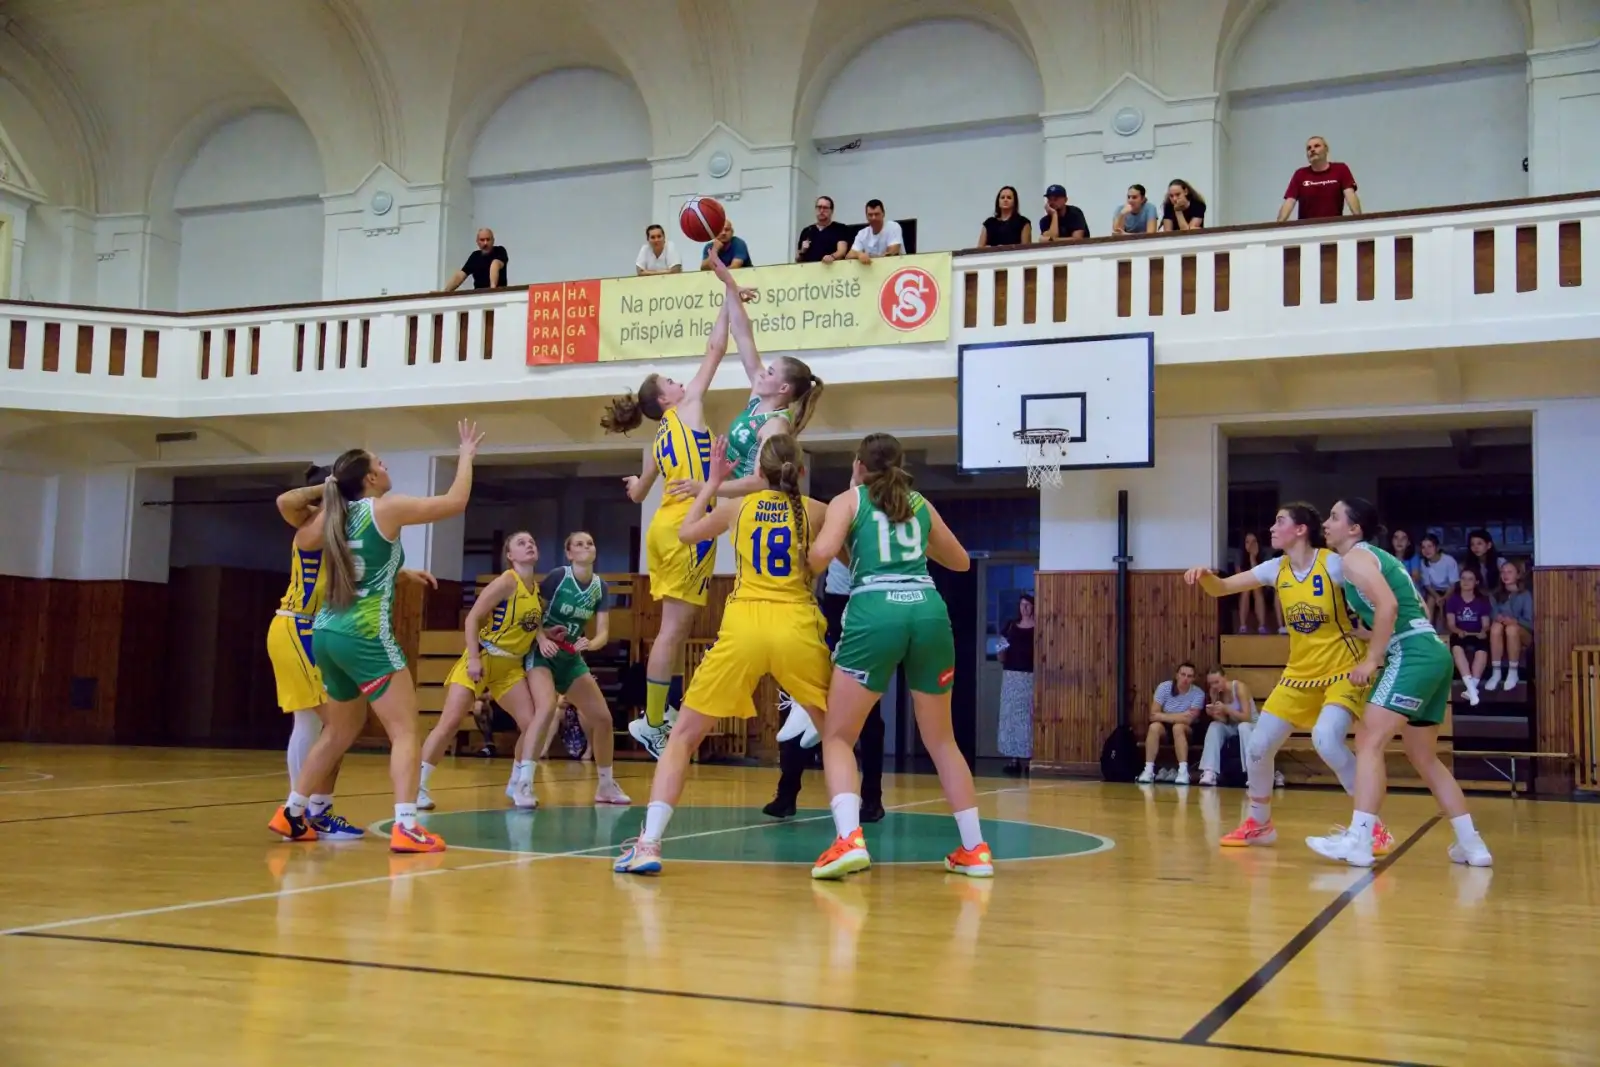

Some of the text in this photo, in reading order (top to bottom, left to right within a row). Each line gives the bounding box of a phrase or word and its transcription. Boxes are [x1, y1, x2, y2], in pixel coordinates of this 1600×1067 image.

[621, 295, 643, 314] Na
[649, 294, 704, 316] provoz
[766, 278, 861, 307] sportoviště
[620, 319, 684, 345] přispívá
[802, 309, 859, 330] Praha.
[731, 422, 750, 444] 14
[656, 430, 678, 472] 14
[755, 511, 789, 523] NUSLE
[757, 500, 789, 511] SOKOL
[872, 510, 923, 563] 19
[751, 526, 792, 577] 18
[1313, 575, 1324, 596] 9
[567, 622, 580, 636] 17
